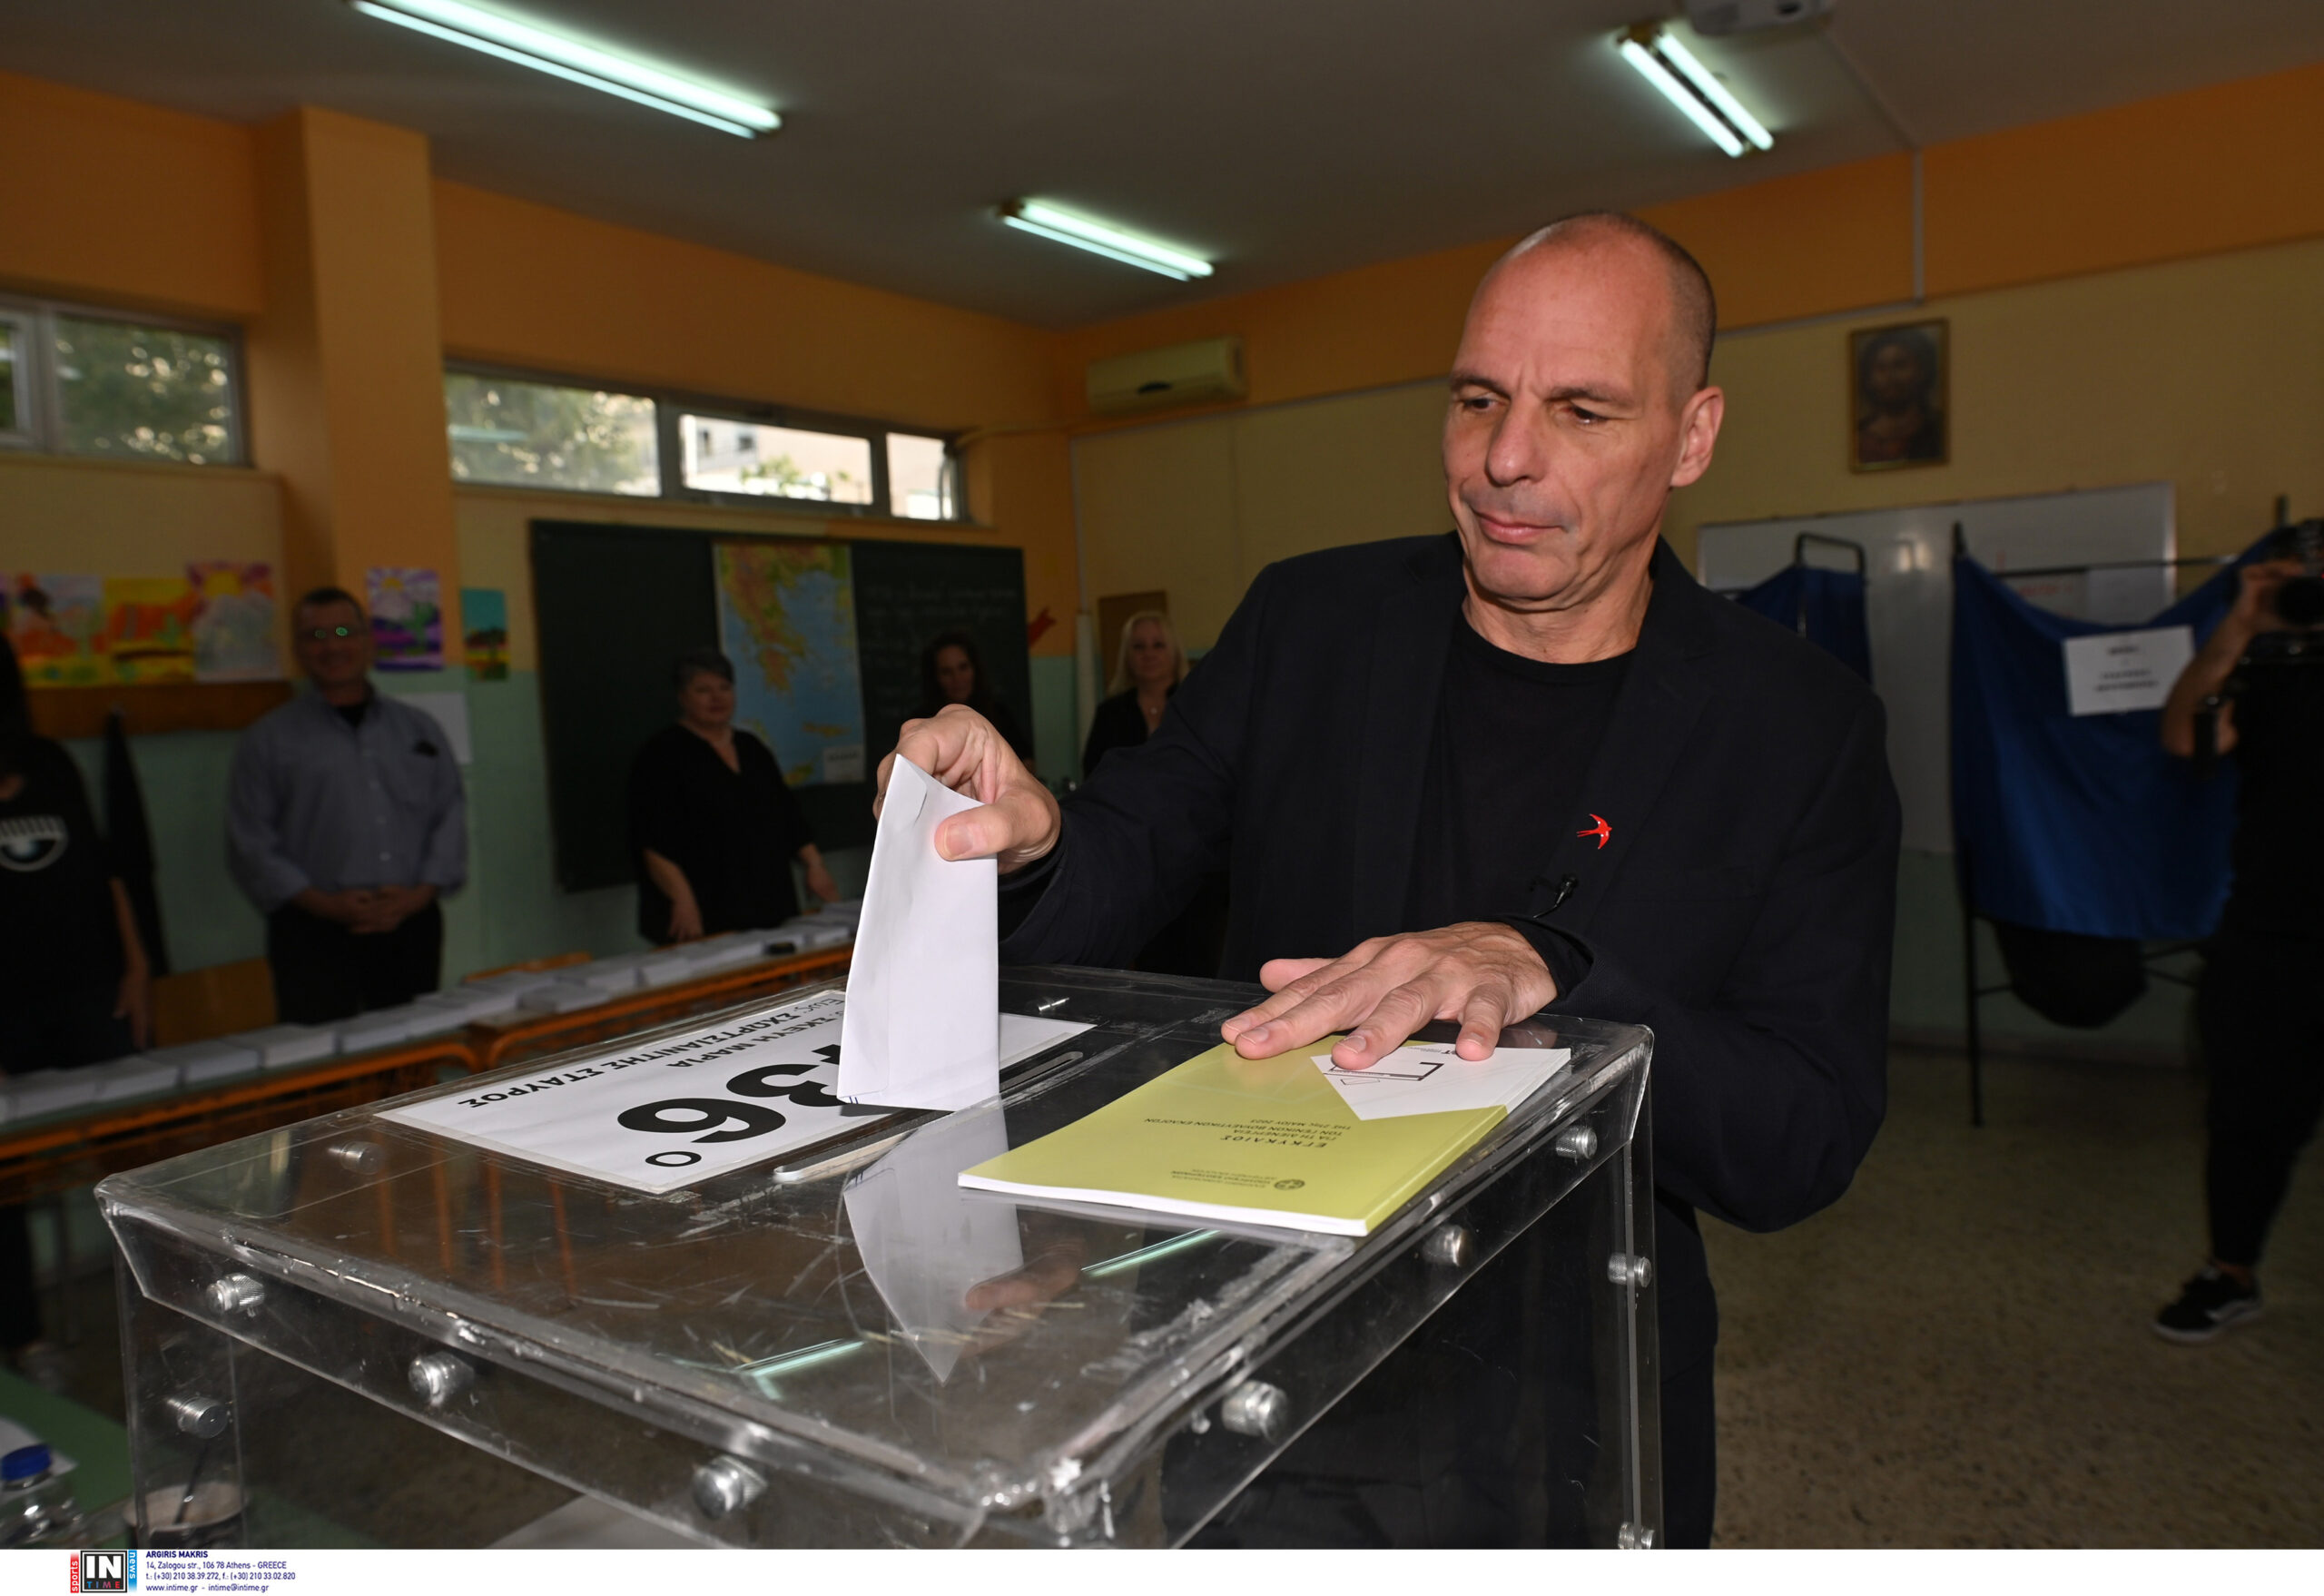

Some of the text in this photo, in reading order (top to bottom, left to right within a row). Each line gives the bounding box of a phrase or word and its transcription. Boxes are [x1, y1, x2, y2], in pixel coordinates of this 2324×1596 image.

[600, 1012, 802, 1070] ΣΧΩΡΤΣΙΑΝΙΤΗΣ
[665, 1017, 837, 1069] ΣΚΕΥΗ ΜΑΡΙΑ
[457, 1068, 606, 1108] ΣΤΑΥΡΟΣ
[1219, 1135, 1327, 1148] ΕΓΚΥΚΛΙΟΣ
